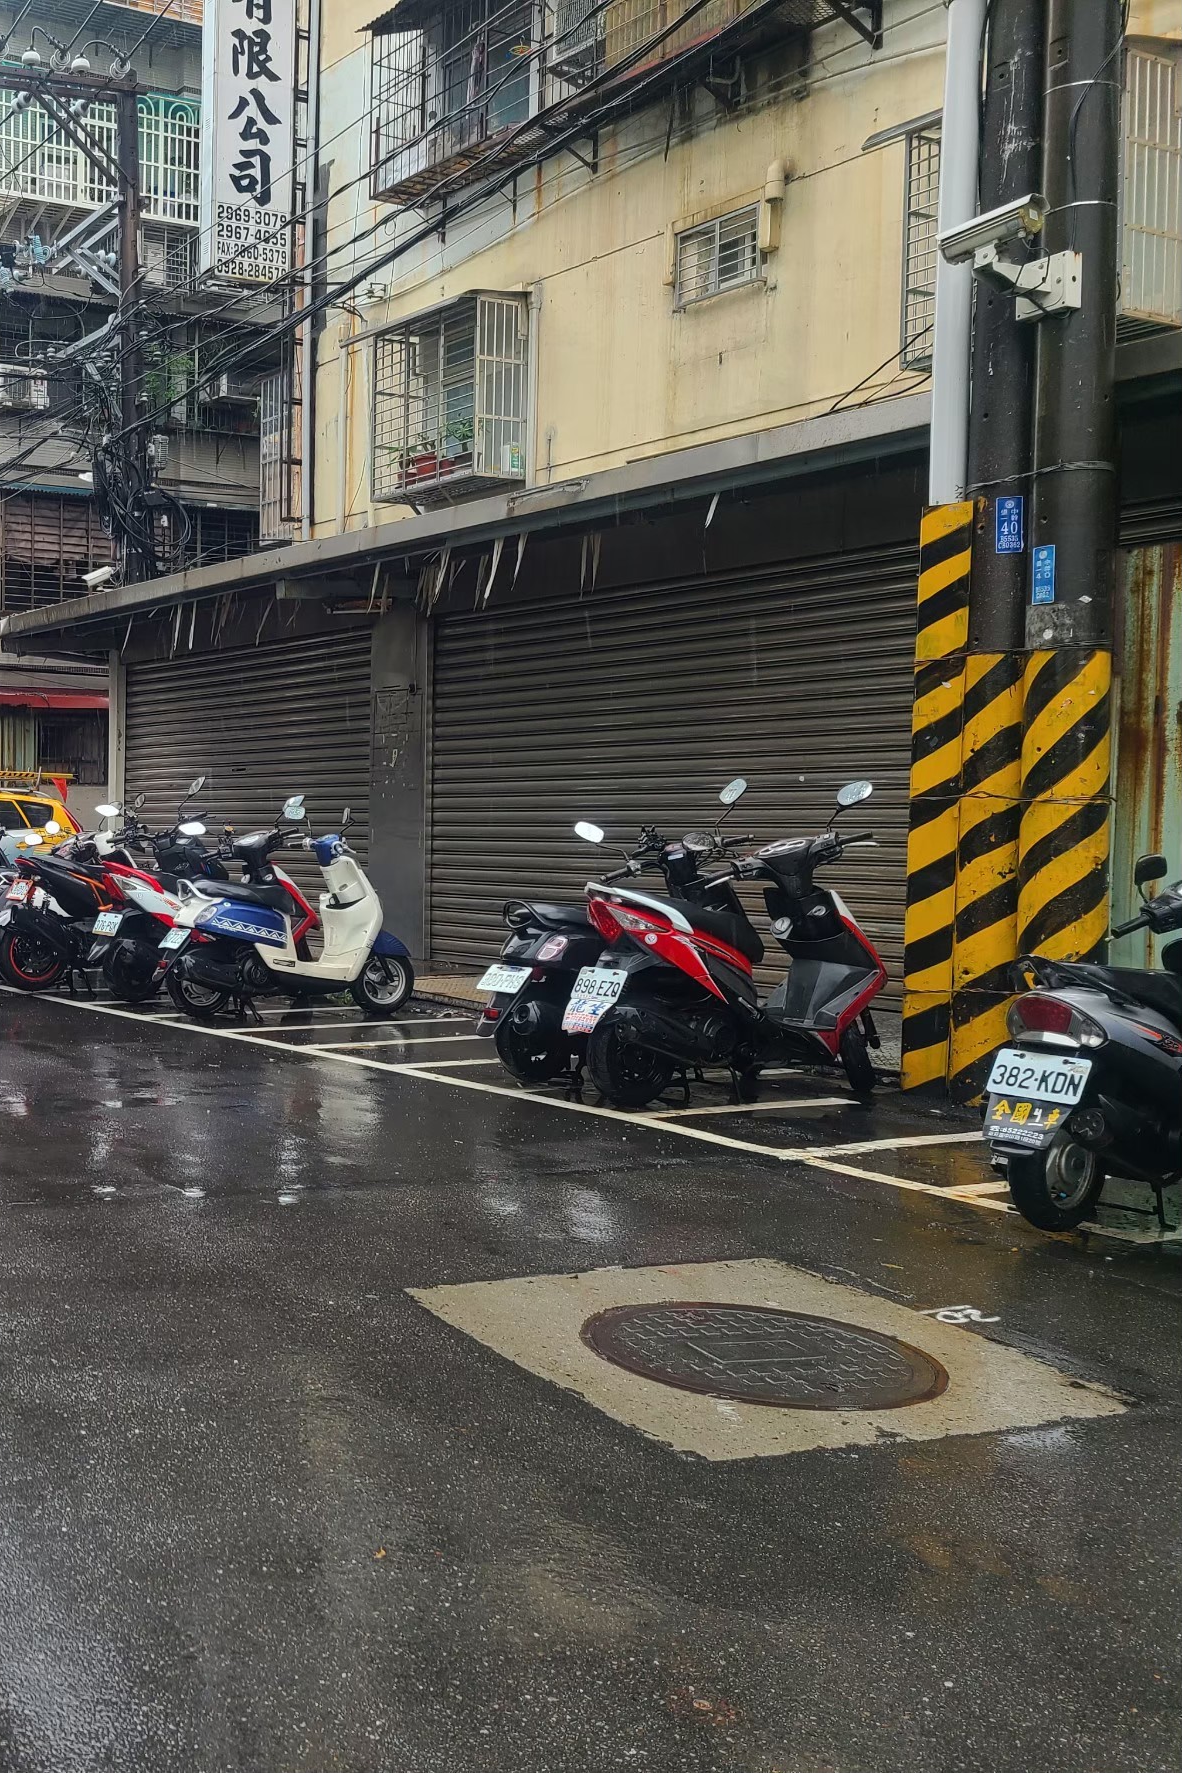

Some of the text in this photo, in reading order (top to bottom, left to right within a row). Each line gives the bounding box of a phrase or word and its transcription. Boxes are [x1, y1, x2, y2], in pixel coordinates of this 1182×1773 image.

[1000, 521, 1019, 534] 40
[574, 978, 621, 998] 898-EZQ
[992, 1064, 1083, 1097] 382-KDN
